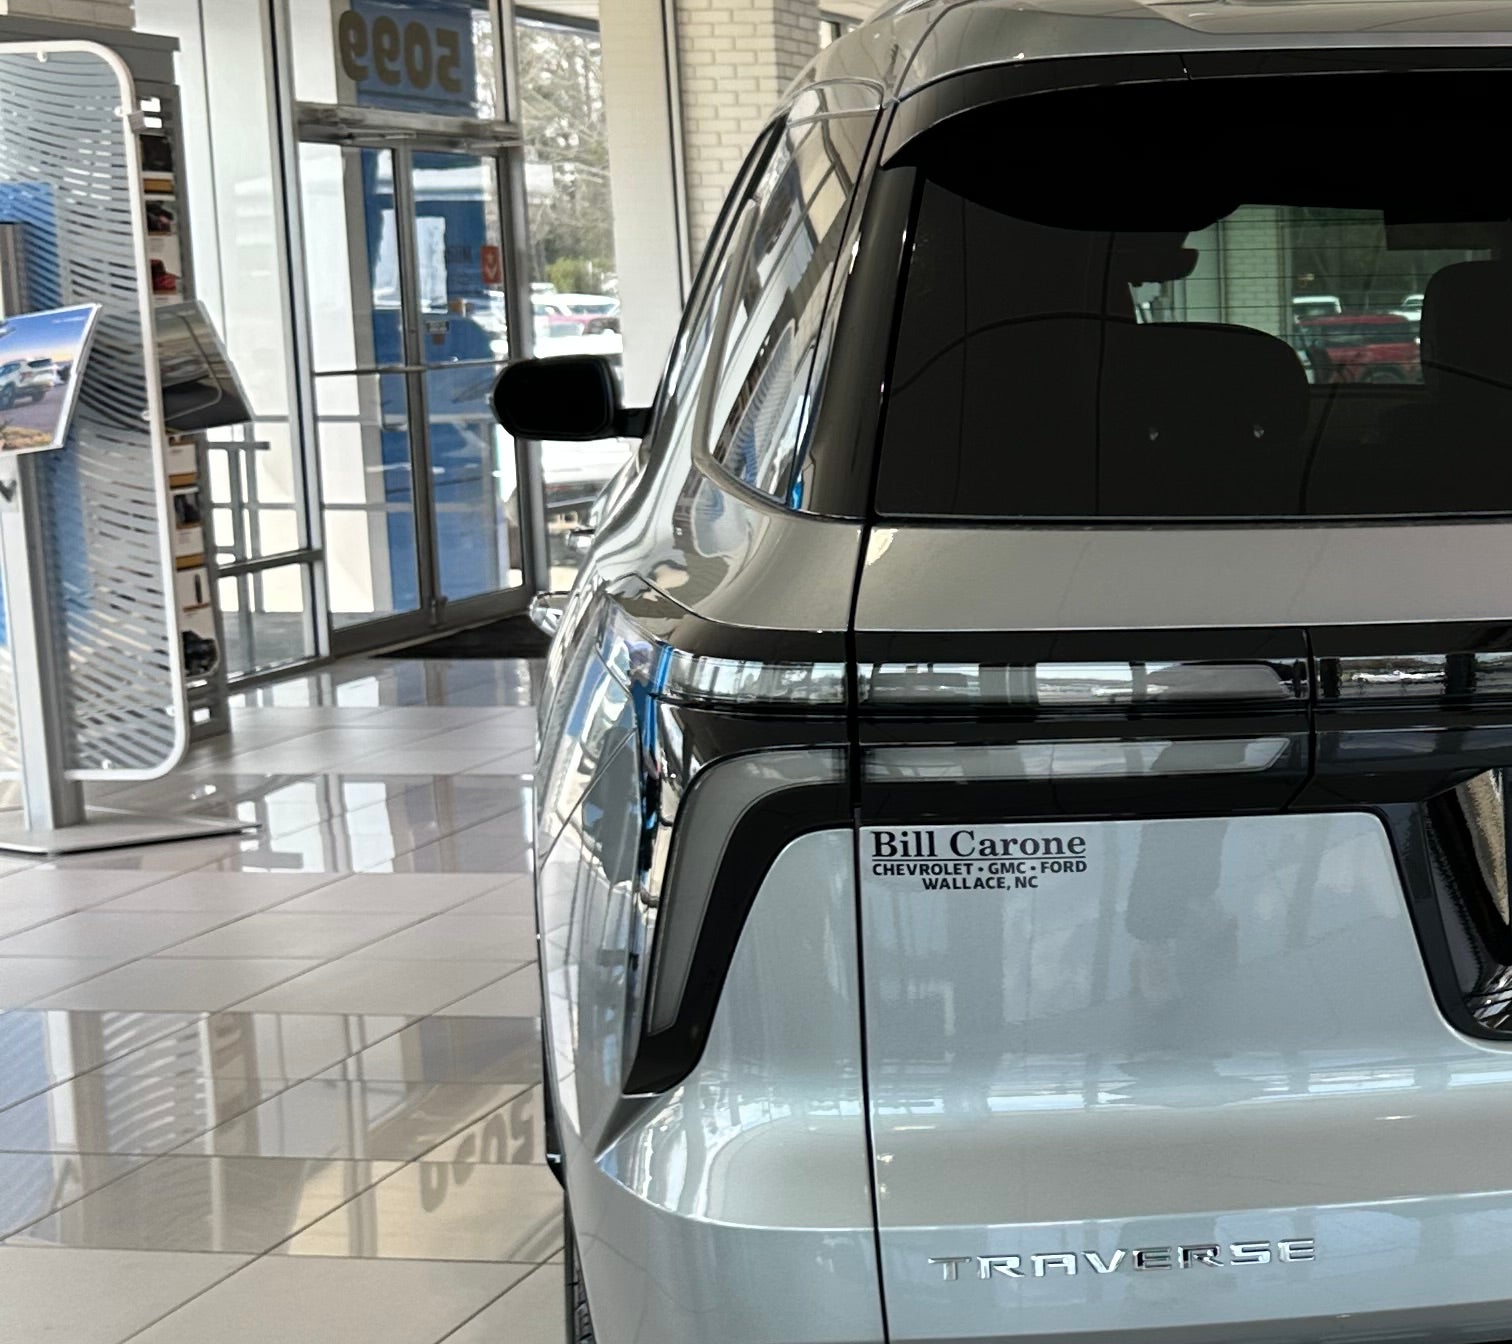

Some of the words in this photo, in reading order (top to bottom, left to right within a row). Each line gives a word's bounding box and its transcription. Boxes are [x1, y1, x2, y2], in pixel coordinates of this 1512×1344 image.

[870, 830, 939, 858] Bill
[949, 829, 1087, 857] Carone
[872, 862, 974, 876] CHEVROLET
[988, 861, 1027, 875] GMC
[1040, 860, 1088, 873] FORD
[922, 876, 1011, 891] WALLACE,
[1014, 875, 1039, 889] NC
[927, 1238, 1317, 1282] TRAVERSE
